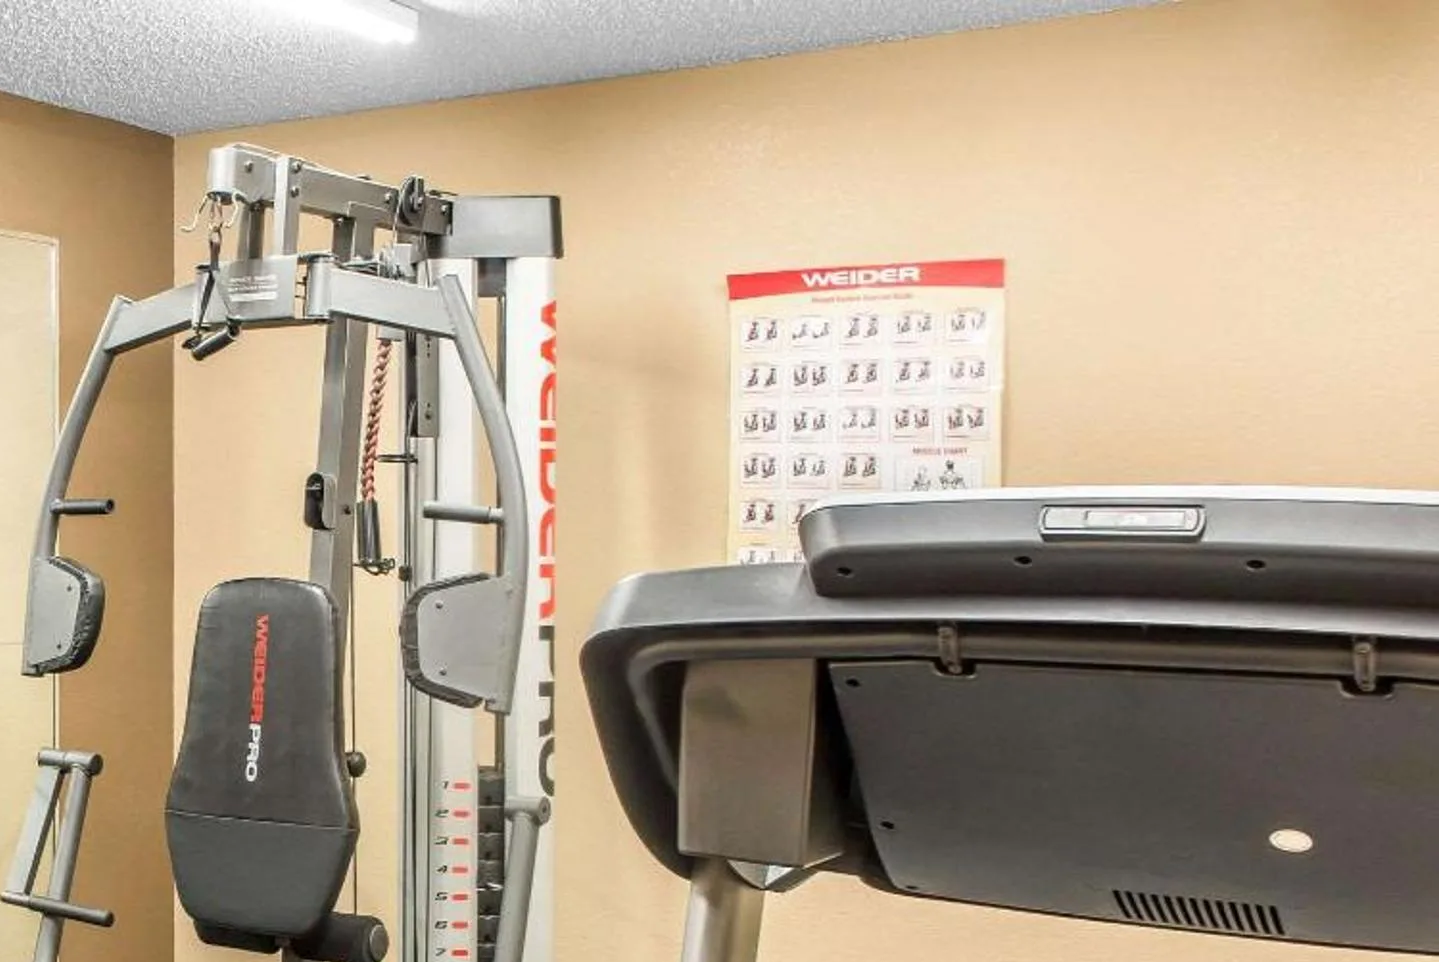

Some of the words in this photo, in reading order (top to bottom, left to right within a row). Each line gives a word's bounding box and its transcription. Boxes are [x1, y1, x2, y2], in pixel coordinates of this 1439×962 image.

[801, 266, 921, 288] WEIDER
[249, 613, 270, 724] WEIDER
[245, 724, 261, 783] PRO
[434, 809, 449, 818] 2
[433, 835, 449, 846] 3
[436, 865, 448, 874] 4
[434, 892, 448, 901] 5
[434, 920, 448, 930] 6
[435, 947, 446, 957] 7
